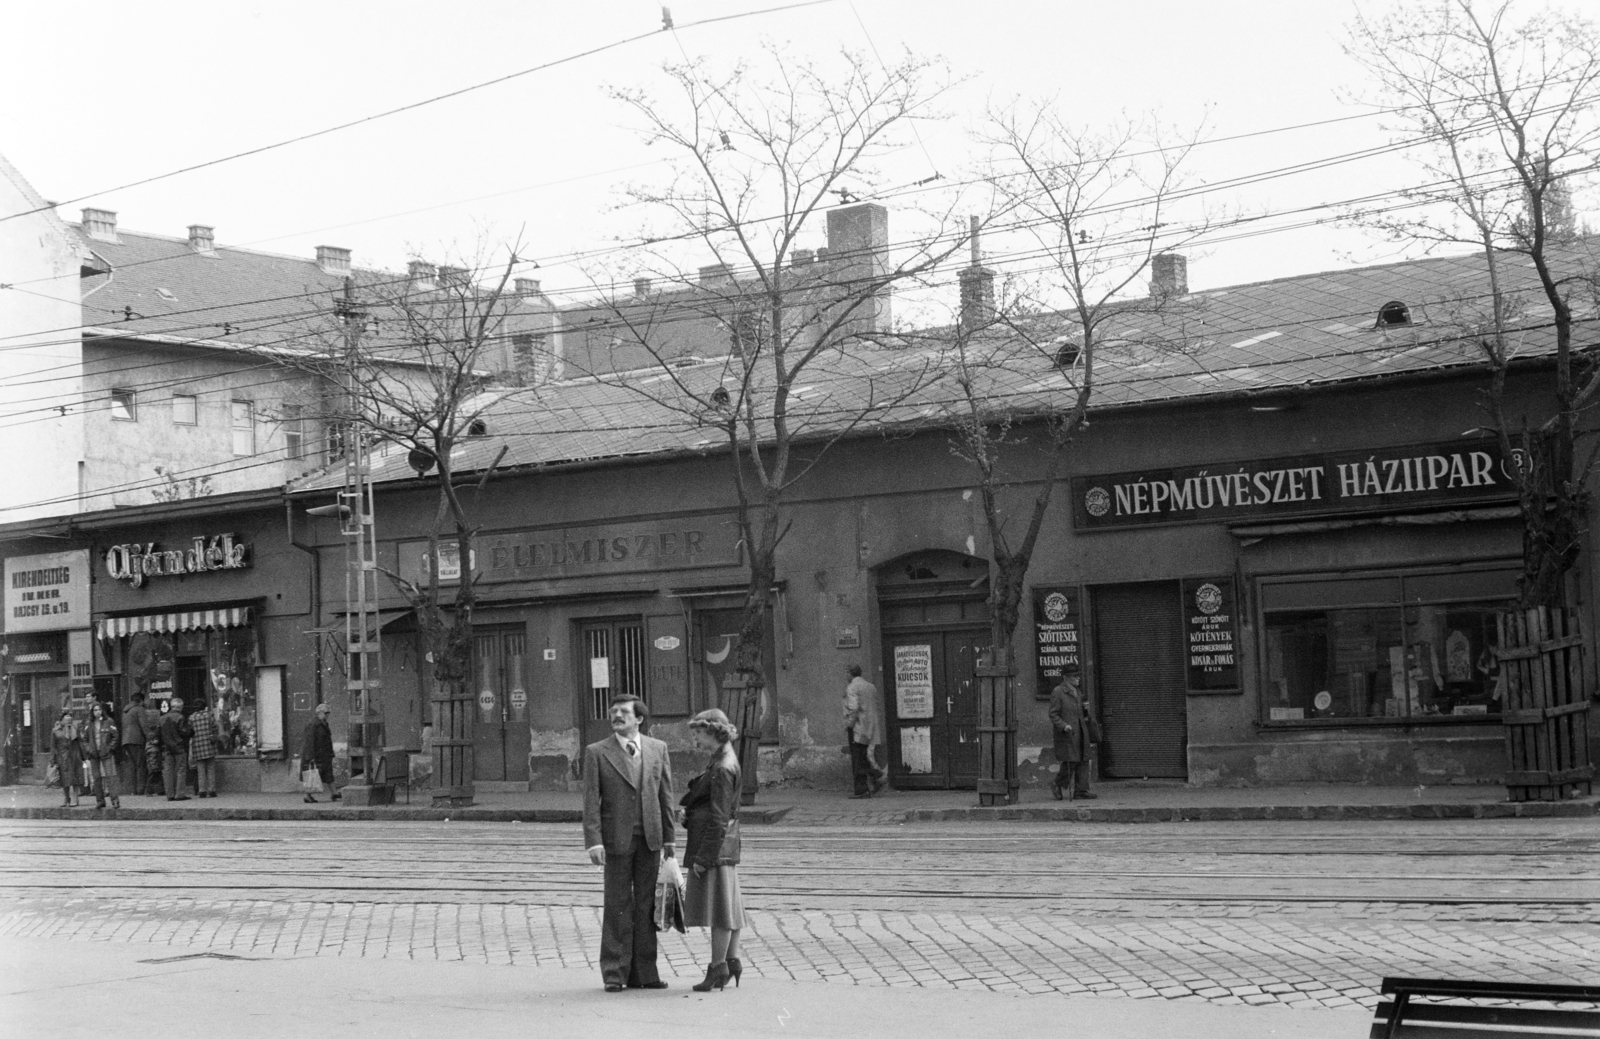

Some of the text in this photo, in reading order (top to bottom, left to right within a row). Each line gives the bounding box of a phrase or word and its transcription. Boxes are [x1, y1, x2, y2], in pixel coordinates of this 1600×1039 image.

[1114, 466, 1324, 515] NÉPMŰVÉSZET
[1340, 451, 1496, 498] HÁZIIPAR
[491, 531, 704, 569] ÉLELMISZER
[12, 566, 70, 589] KIRENDELTSÉG
[13, 605, 40, 618] BAJCSY
[1038, 630, 1078, 643] SZŐTTESEK
[1190, 630, 1232, 642] KÖTÉNYEK
[1191, 642, 1233, 653] GYERMEKRUHÁK
[1039, 653, 1079, 666] FAFARAGÁS
[1191, 653, 1211, 666] KOSÁR
[1214, 652, 1234, 665] FONÁS
[898, 672, 929, 682] KULCSOK
[1044, 667, 1062, 677] CSERÉ
